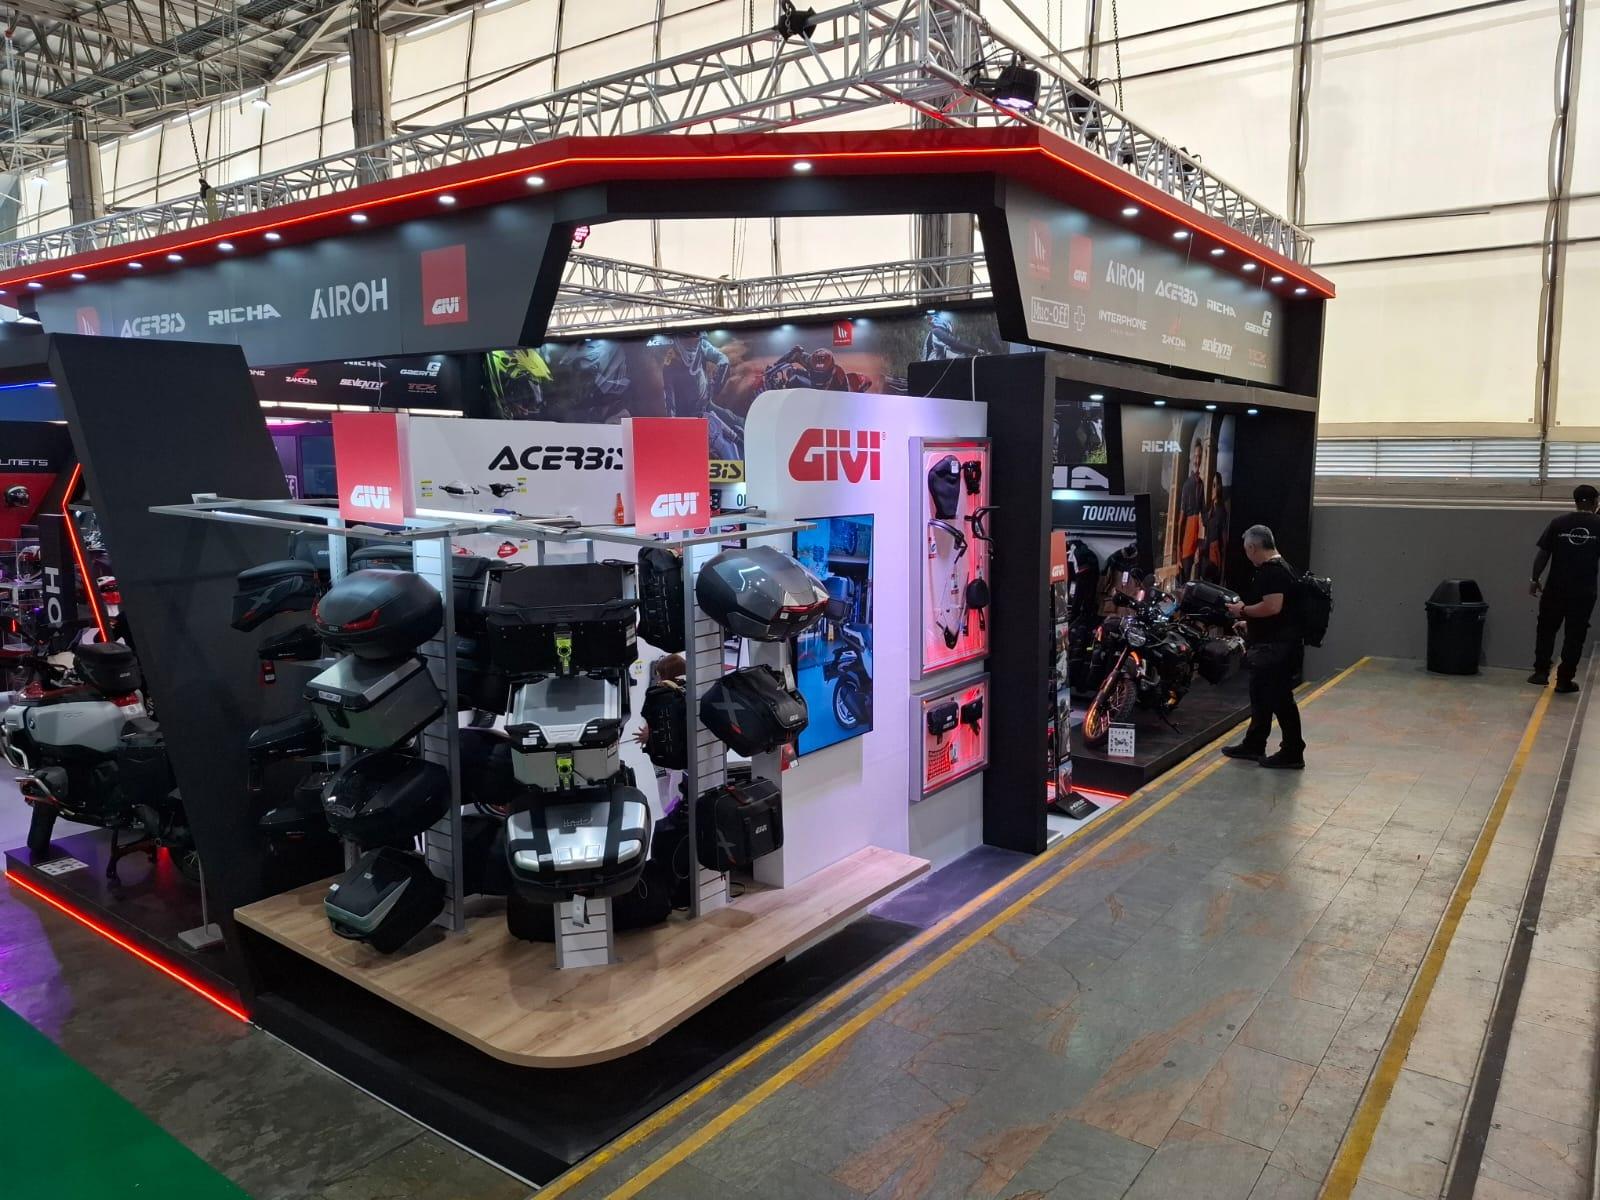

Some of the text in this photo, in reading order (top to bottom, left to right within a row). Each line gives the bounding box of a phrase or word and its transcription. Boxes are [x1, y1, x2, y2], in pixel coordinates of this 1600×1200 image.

[1106, 260, 1145, 292] AIROH
[310, 277, 388, 320] AIROH
[431, 296, 460, 315] GIVI
[1155, 280, 1199, 307] ACERBIS
[208, 303, 281, 326] RICHA
[1206, 299, 1237, 318] RICHA
[120, 312, 186, 338] ACERBIS
[788, 428, 881, 483] GIVI
[1141, 440, 1183, 453] RICHA
[350, 485, 391, 510] GIVI
[650, 492, 697, 518] GIVI
[1082, 505, 1136, 523] TOURING
